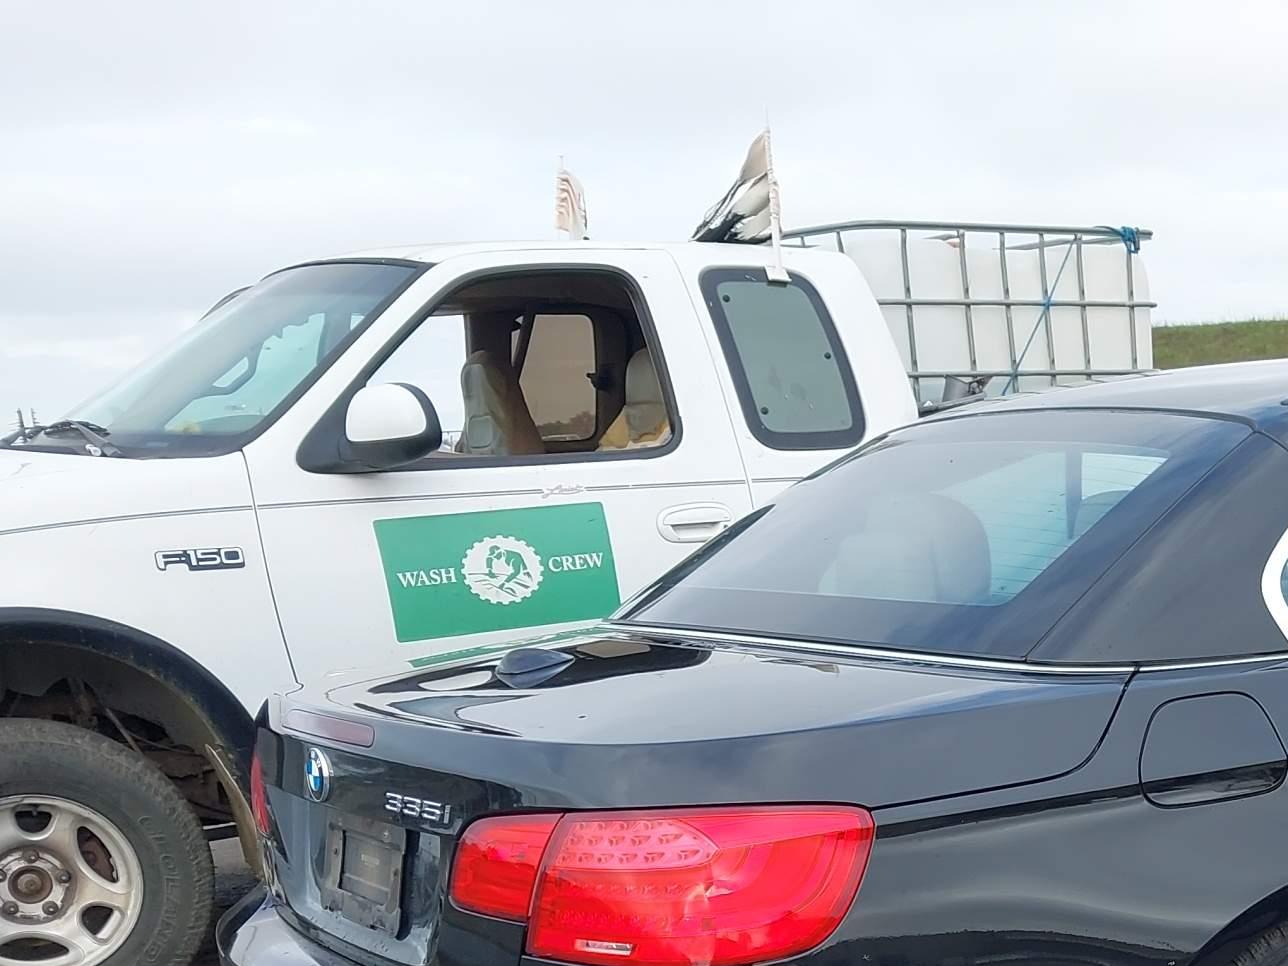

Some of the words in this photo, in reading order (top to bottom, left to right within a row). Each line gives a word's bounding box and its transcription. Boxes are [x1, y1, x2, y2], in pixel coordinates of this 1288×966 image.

[154, 547, 245, 570] F-150
[396, 567, 457, 588] WASH
[548, 552, 604, 573] CREW
[384, 792, 451, 824] 335i
